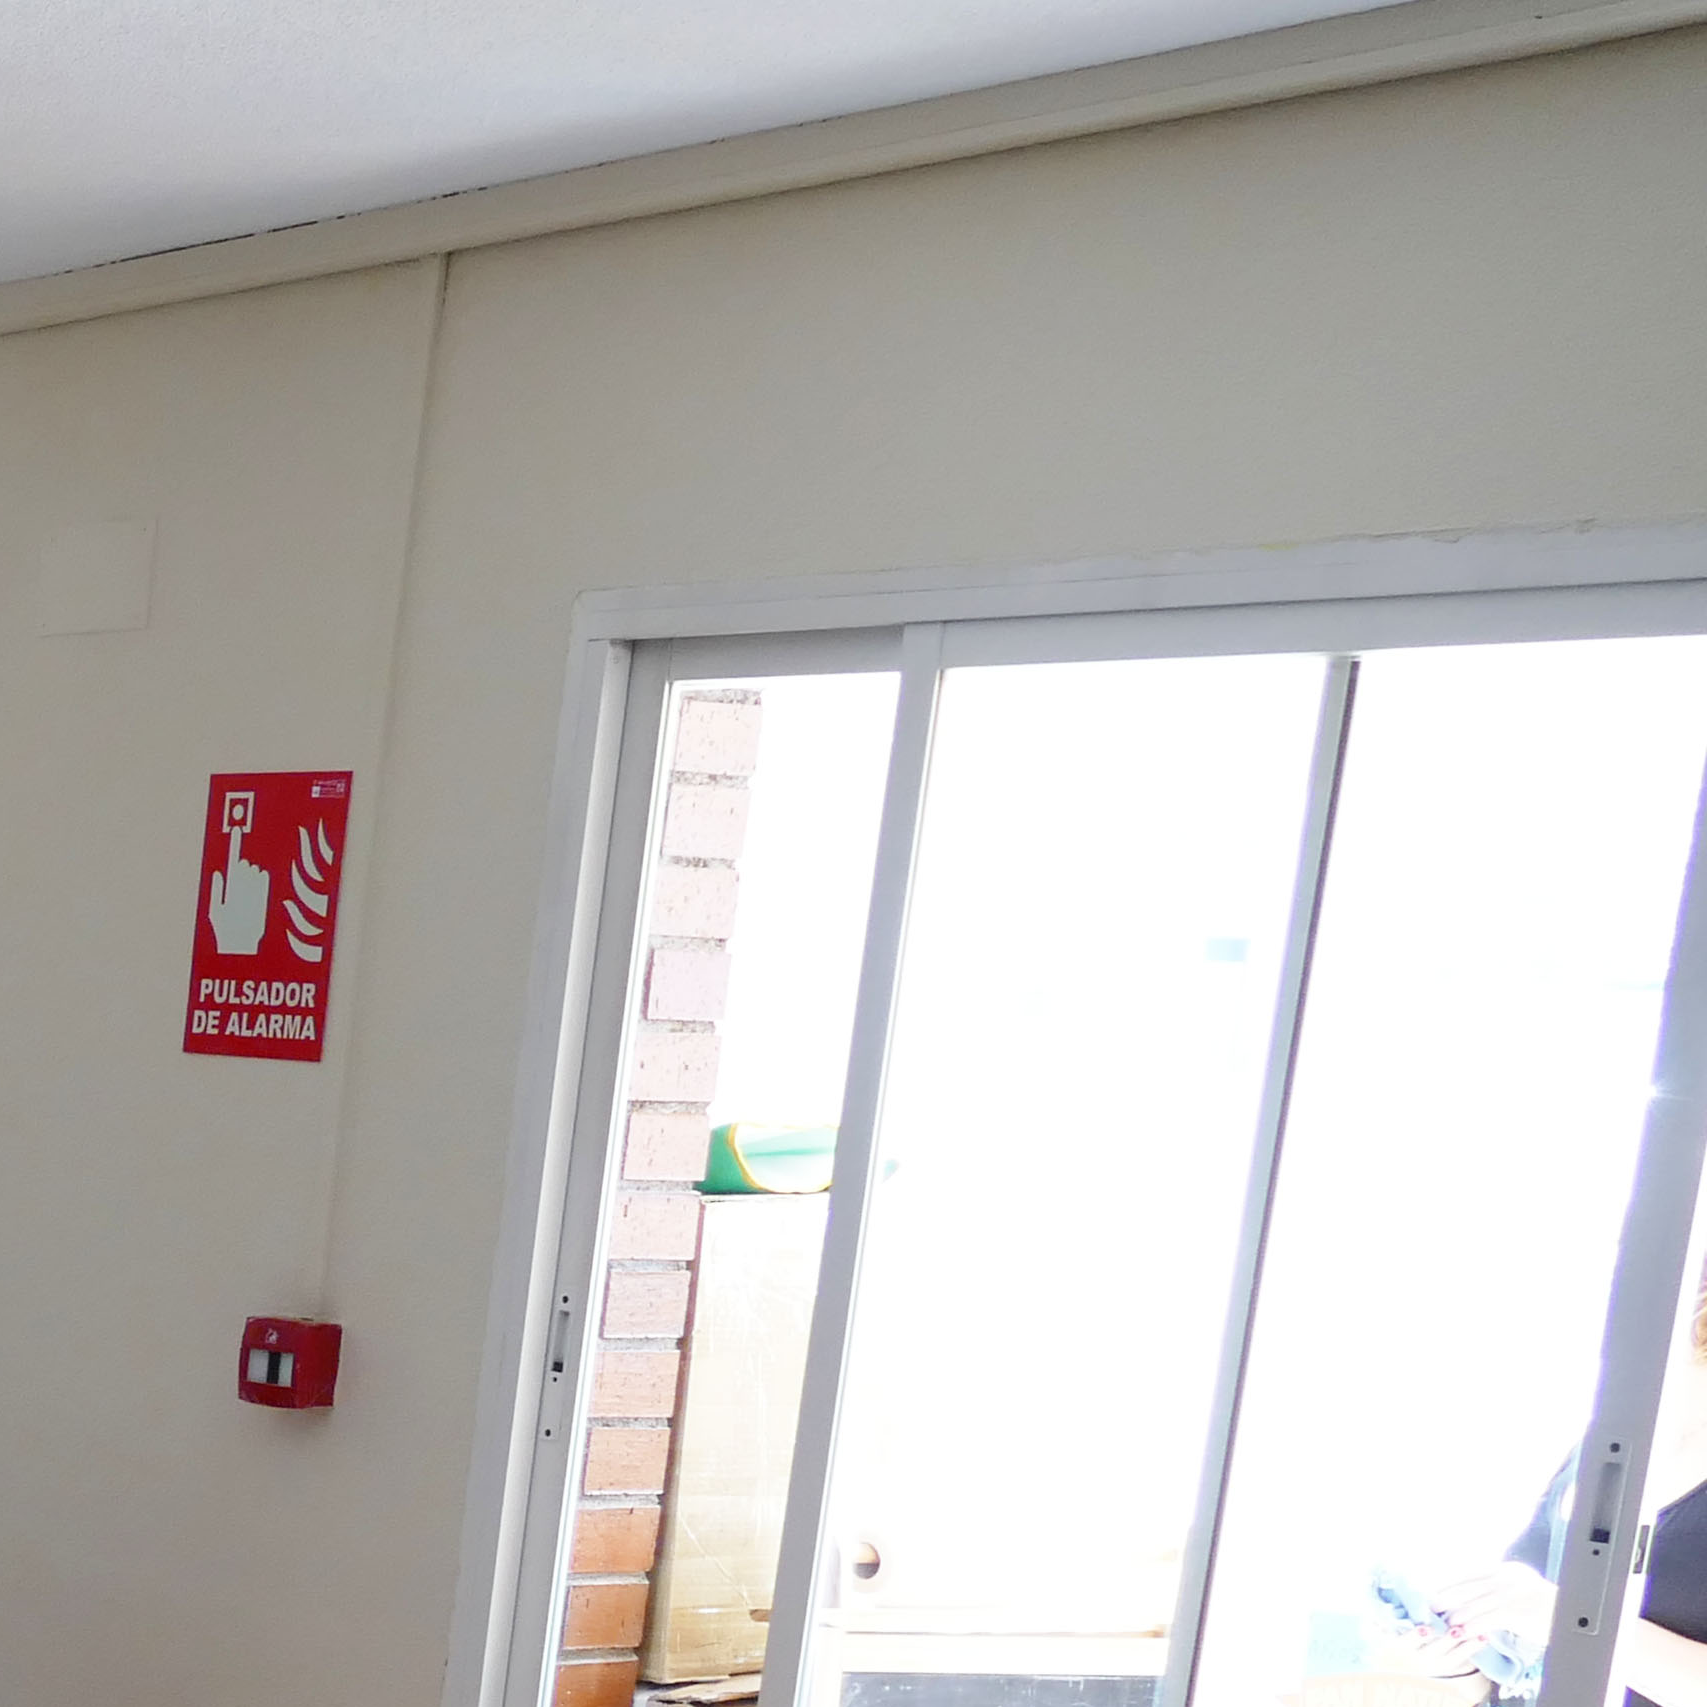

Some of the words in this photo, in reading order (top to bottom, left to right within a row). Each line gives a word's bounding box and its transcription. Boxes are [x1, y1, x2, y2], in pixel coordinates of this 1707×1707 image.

[199, 978, 316, 1008] PULSADOR
[192, 1010, 220, 1035] DE
[225, 1011, 316, 1040] ALARMA
